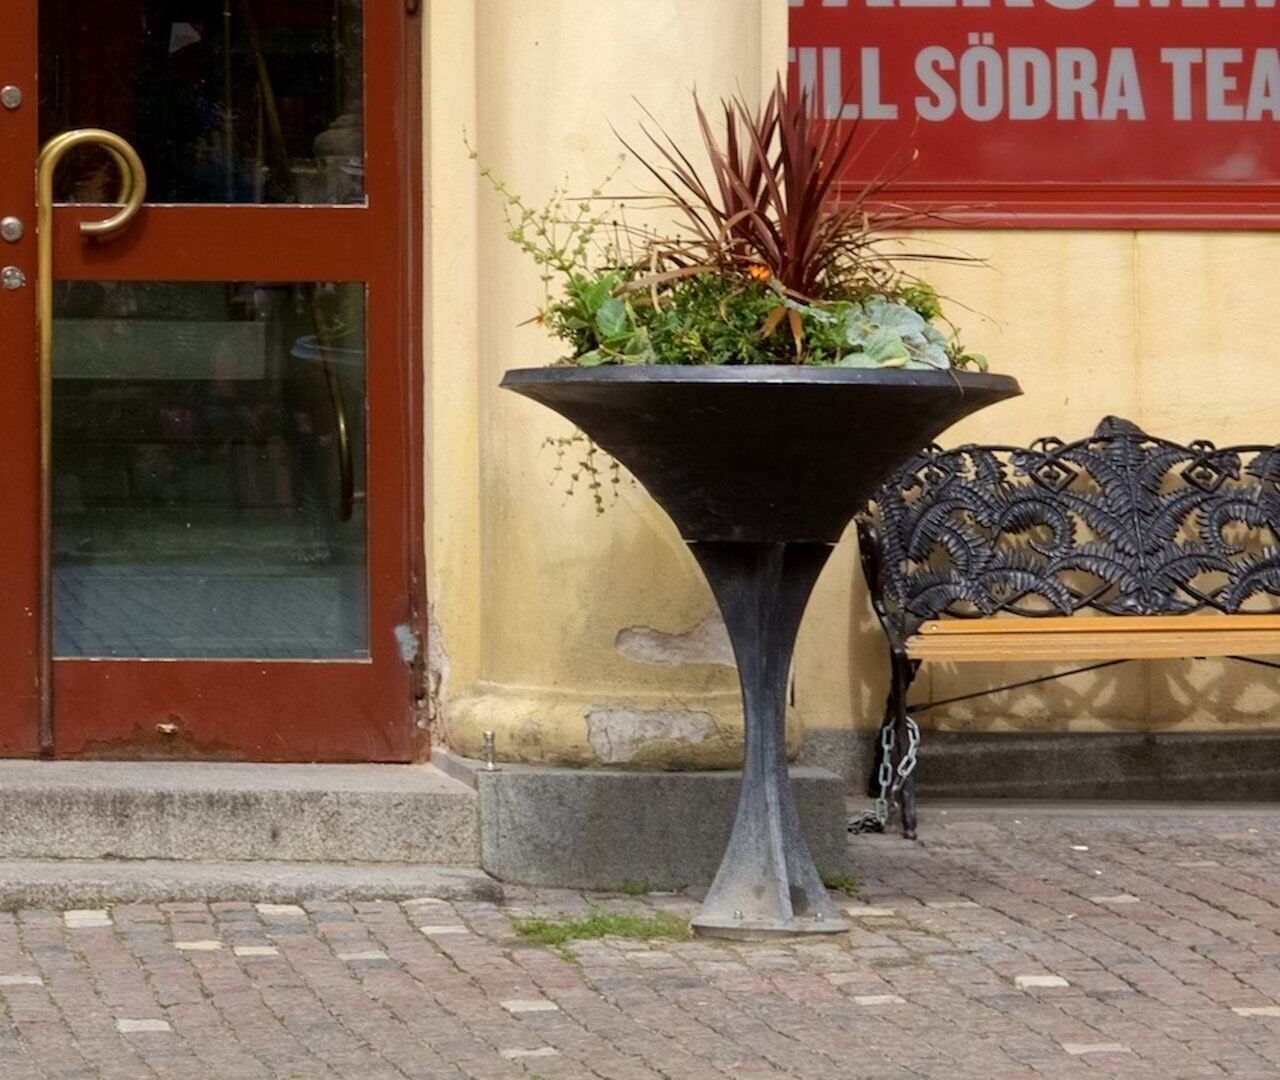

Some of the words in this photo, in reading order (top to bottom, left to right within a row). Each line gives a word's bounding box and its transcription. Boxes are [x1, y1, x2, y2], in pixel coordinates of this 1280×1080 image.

[788, 47, 898, 121] ILL
[914, 32, 1146, 122] SÖDRA
[1160, 47, 1280, 121] TEA
